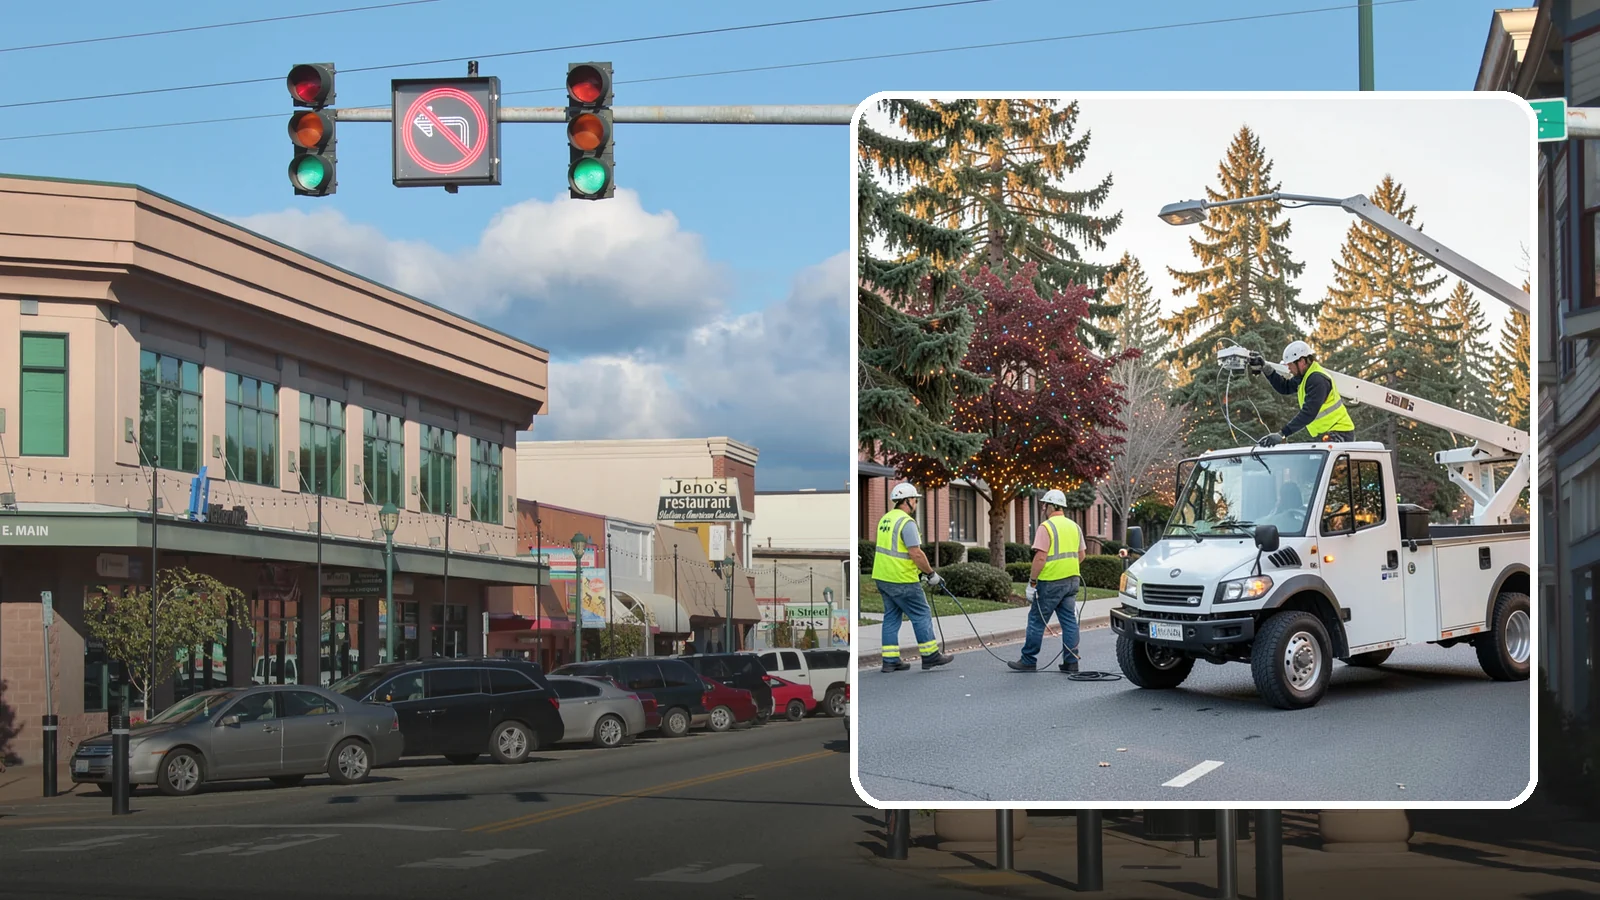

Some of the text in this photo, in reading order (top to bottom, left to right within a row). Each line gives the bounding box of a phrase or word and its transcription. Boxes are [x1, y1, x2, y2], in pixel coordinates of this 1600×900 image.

[669, 480, 728, 495] Jeno's
[665, 496, 731, 509] restaurant
[659, 510, 682, 520] Italian
[686, 509, 715, 519] American
[715, 509, 737, 519] Cuisine
[2, 525, 49, 536] E. MAIN
[797, 607, 828, 617] Street
[791, 619, 823, 627] lass
